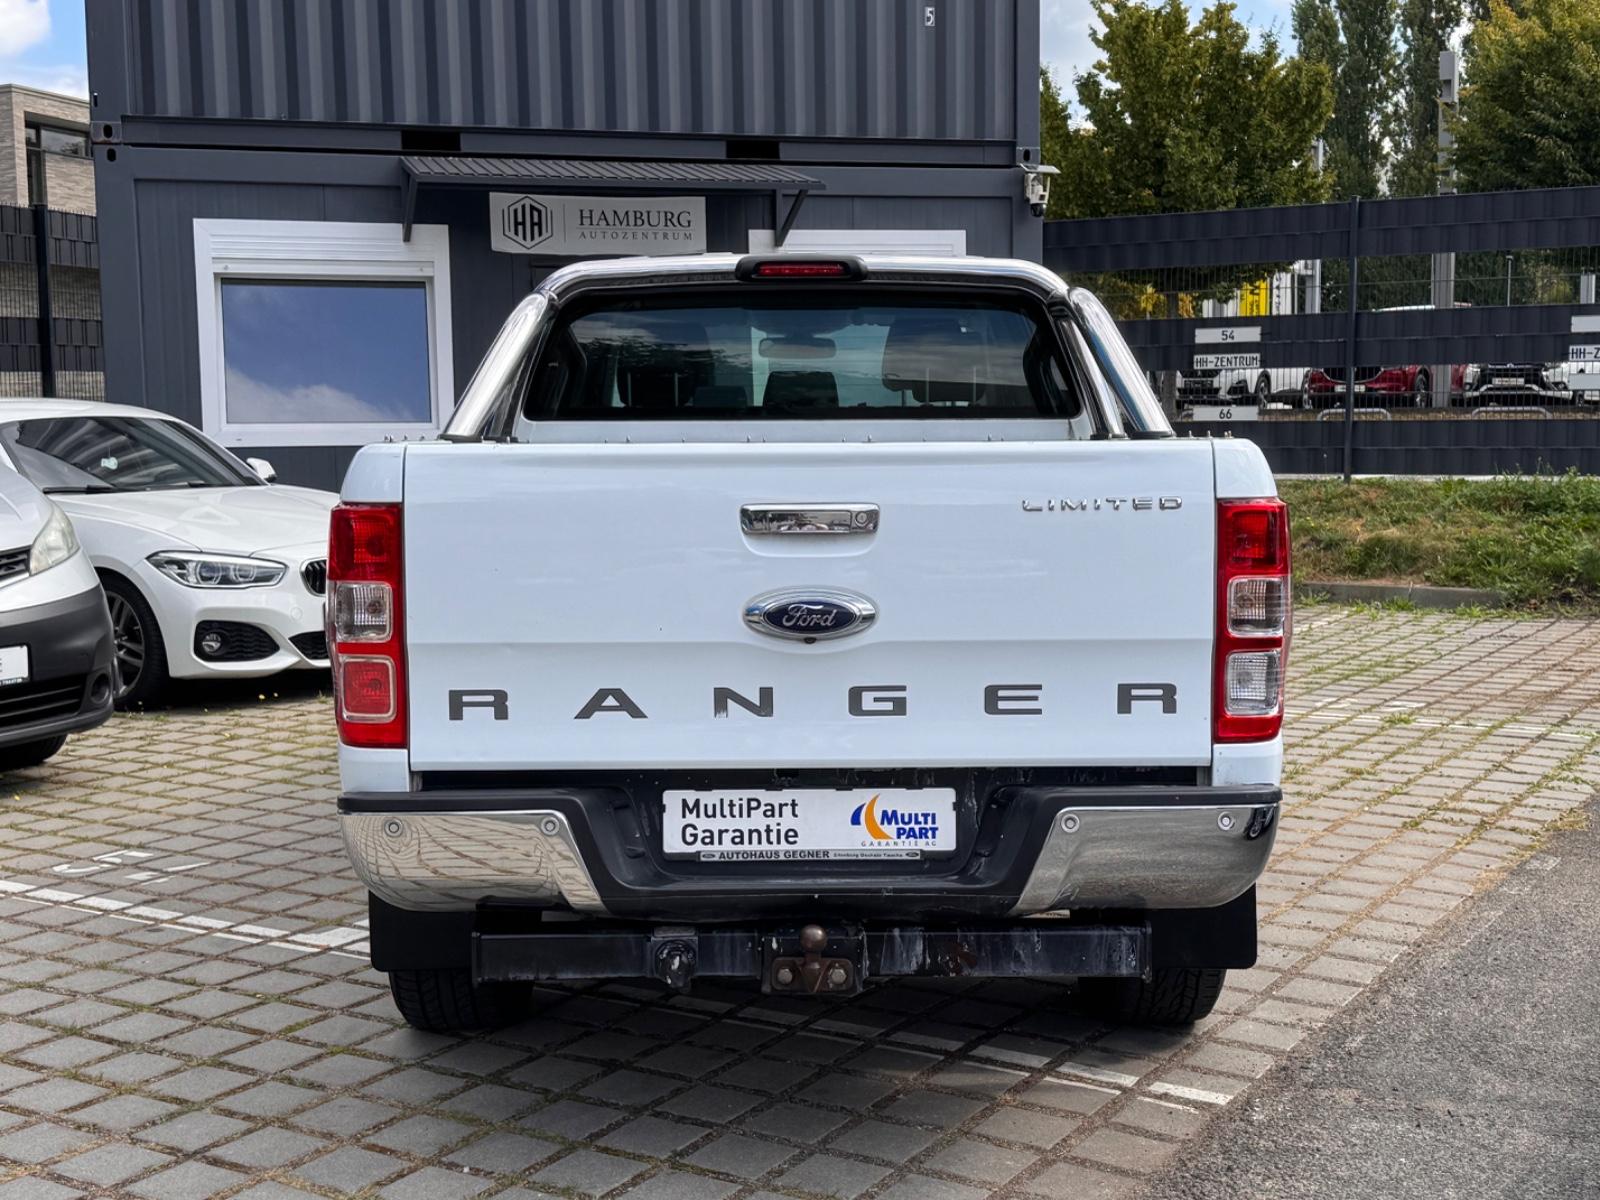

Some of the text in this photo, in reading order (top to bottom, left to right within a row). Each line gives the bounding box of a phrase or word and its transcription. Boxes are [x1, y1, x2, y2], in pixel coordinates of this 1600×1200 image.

[926, 7, 935, 26] 5
[578, 208, 692, 229] HAMBURG
[578, 231, 693, 241] AUTOZENTRUM
[1221, 330, 1235, 341] 54
[1195, 355, 1258, 368] HH-ZENTRUM
[1218, 409, 1232, 419] 66
[1022, 496, 1182, 512] LIMITED
[782, 604, 838, 627] Ford
[448, 683, 1177, 720] RANGER
[681, 798, 799, 819] MultiPart
[880, 809, 936, 826] MULTI
[681, 823, 799, 847] Garantie
[896, 827, 939, 839] PART
[719, 851, 780, 860] AUTOHAUS
[783, 850, 830, 859] GEGNER
